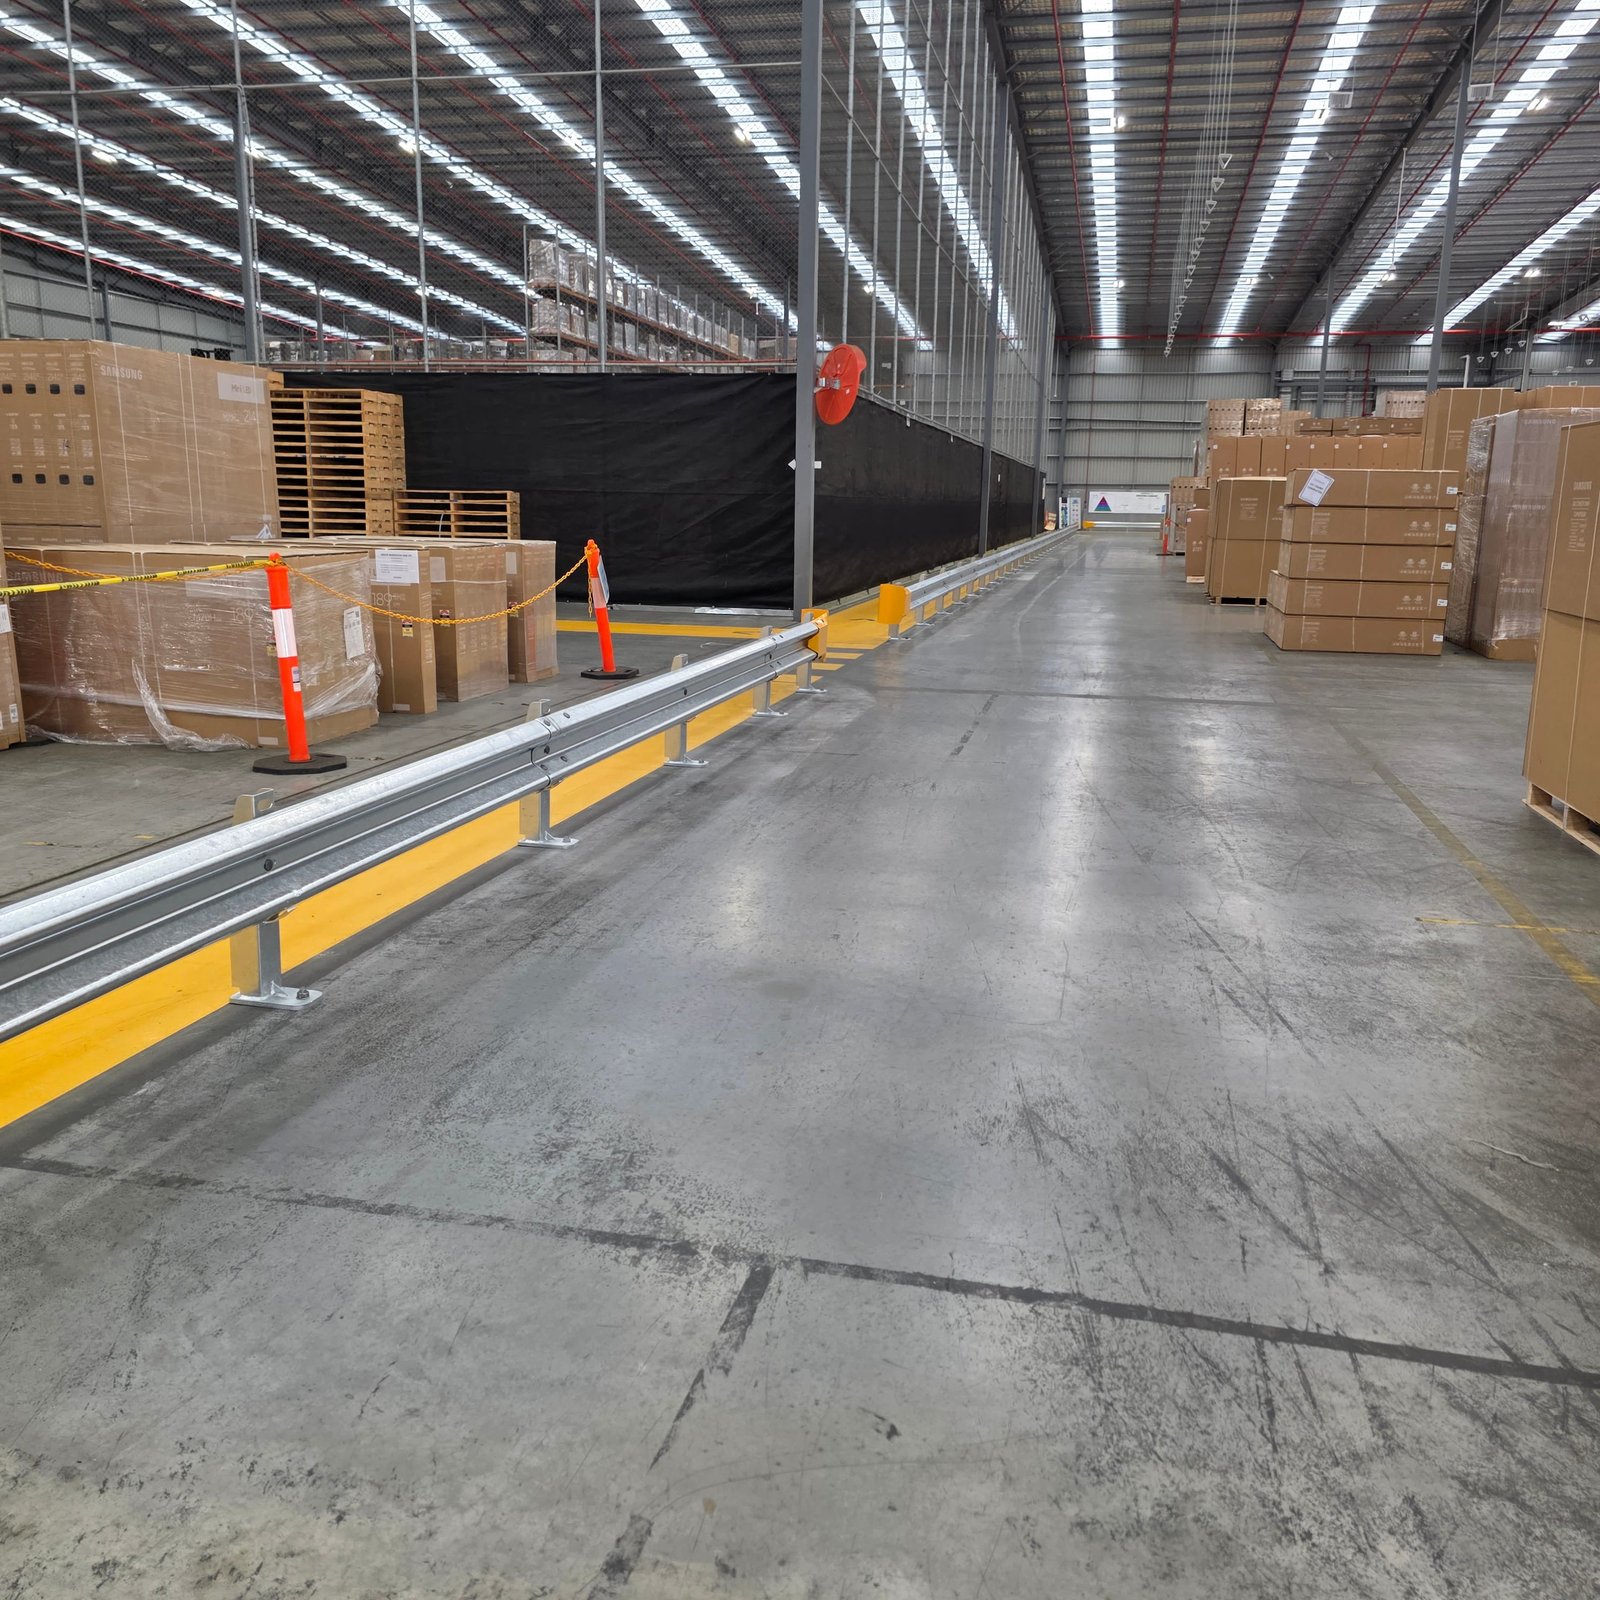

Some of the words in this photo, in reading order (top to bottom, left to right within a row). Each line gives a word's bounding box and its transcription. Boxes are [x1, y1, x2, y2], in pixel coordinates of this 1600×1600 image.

[100, 365, 143, 380] SAMSUNG
[8, 571, 63, 582] SAMSUNG
[371, 592, 392, 606] 189
[231, 607, 254, 621] 189
